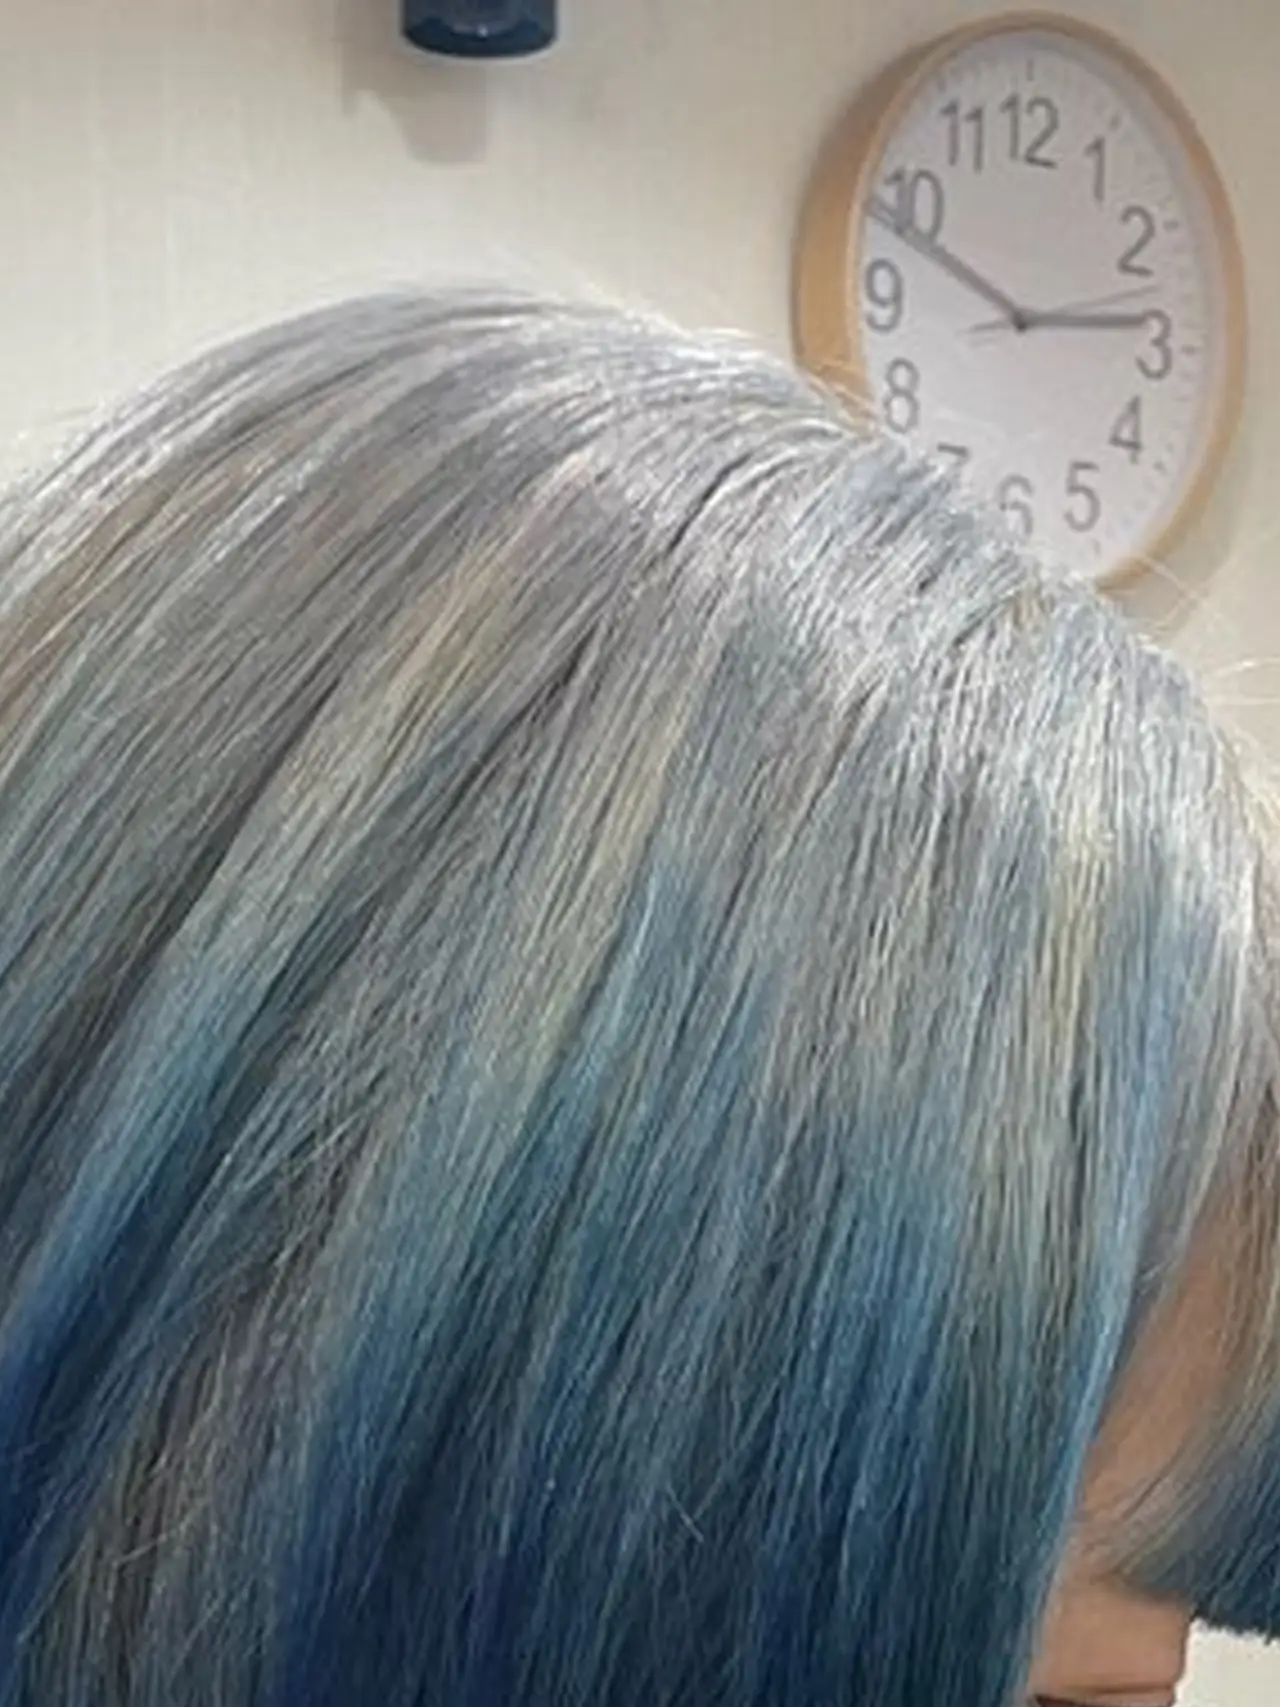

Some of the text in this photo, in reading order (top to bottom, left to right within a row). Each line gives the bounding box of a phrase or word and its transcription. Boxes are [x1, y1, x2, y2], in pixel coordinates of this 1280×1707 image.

[939, 97, 984, 174] 11
[1000, 92, 1059, 170] 12
[884, 166, 944, 244] 10
[1083, 135, 1106, 203] 1
[1117, 205, 1156, 278] 2
[864, 258, 903, 334] 9
[1135, 308, 1172, 381] 3
[883, 357, 919, 434] 8
[1109, 396, 1143, 465] 4
[1065, 460, 1102, 533] 5
